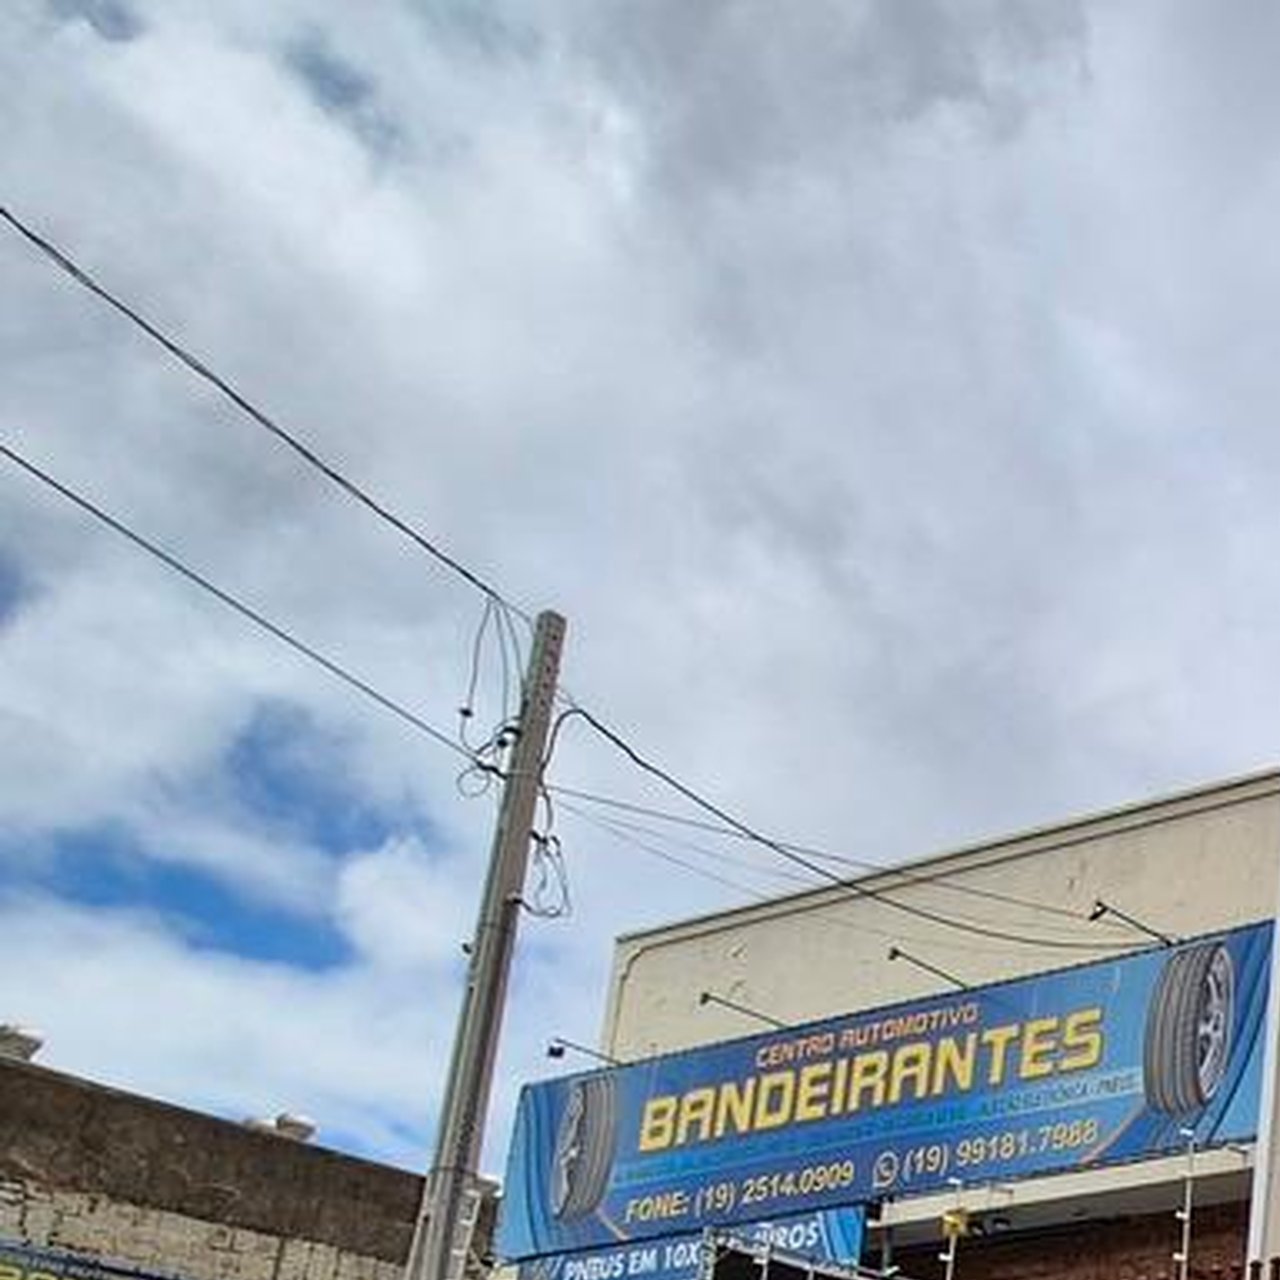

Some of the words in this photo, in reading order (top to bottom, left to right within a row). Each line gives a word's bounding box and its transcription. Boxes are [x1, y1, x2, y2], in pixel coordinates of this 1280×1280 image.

[756, 1032, 834, 1068] CENTRO
[840, 1003, 979, 1048] AUTOMOTIVO
[639, 1008, 1102, 1152] BANDEIRANTES
[625, 1190, 689, 1223] FONE:
[694, 1182, 736, 1218] (19)
[903, 1144, 949, 1182] (19)
[628, 1249, 658, 1275] EM
